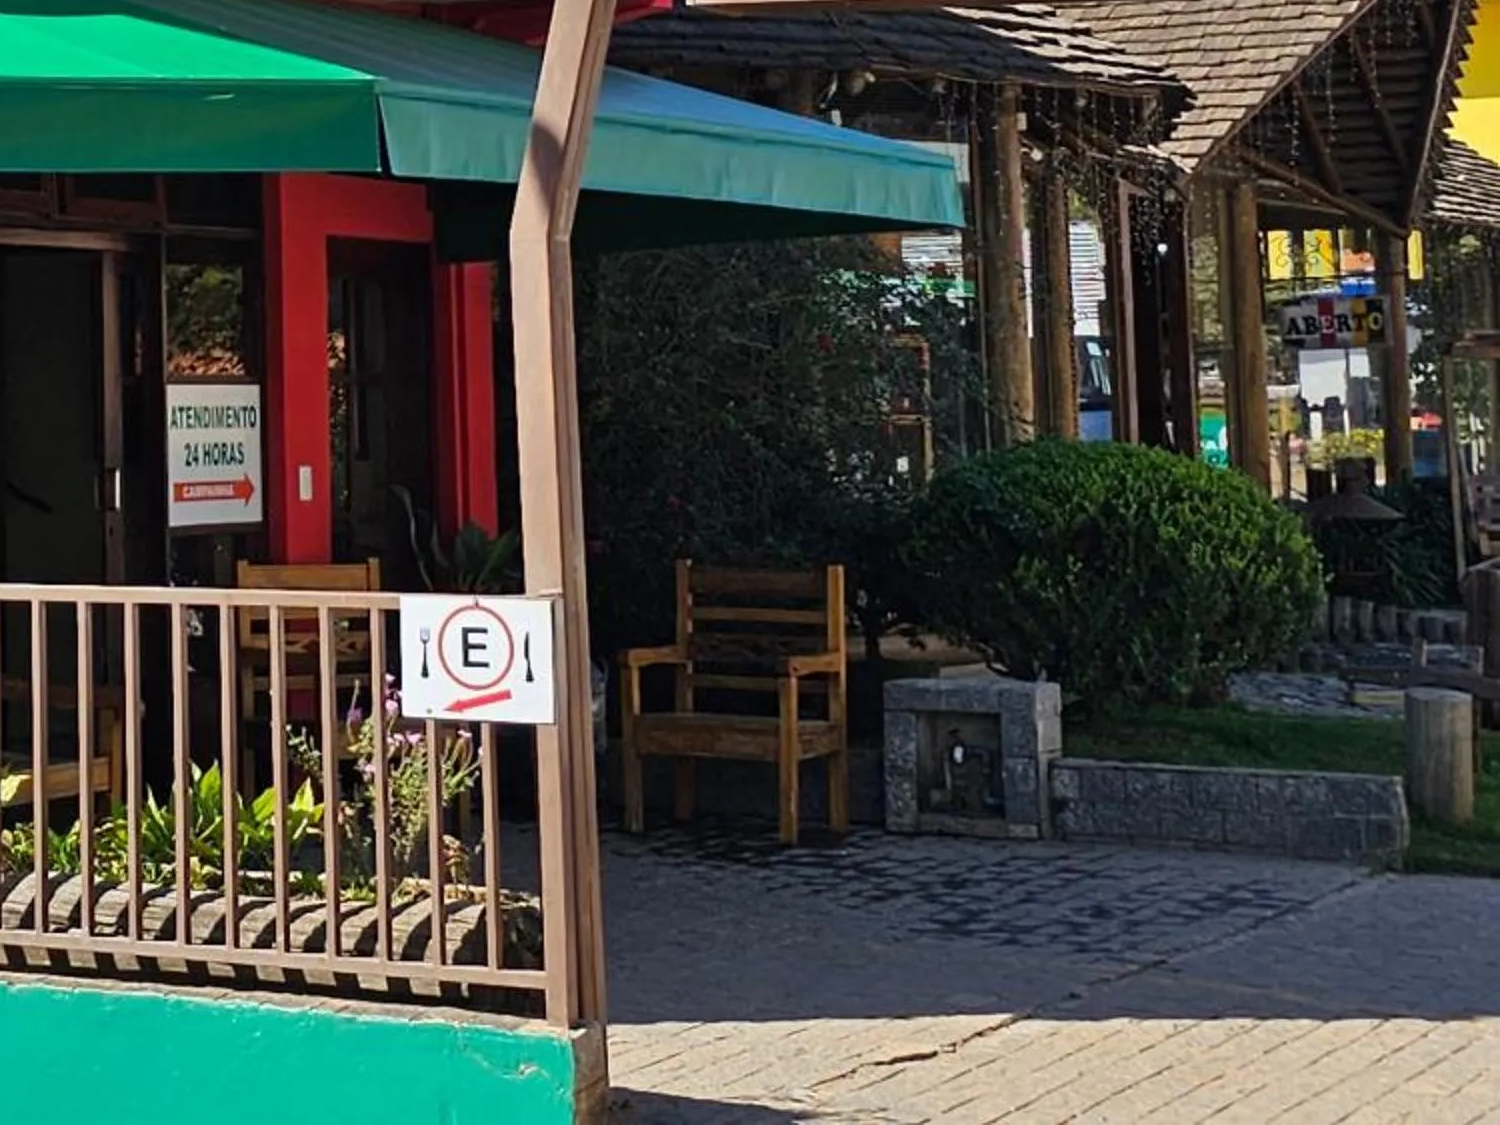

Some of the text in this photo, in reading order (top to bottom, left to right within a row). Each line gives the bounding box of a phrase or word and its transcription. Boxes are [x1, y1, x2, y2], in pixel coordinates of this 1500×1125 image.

[1286, 312, 1383, 335] ABERTO
[170, 405, 257, 428] ATENDIMENTO
[184, 441, 245, 467] 24 HORAS
[461, 627, 490, 668] E
